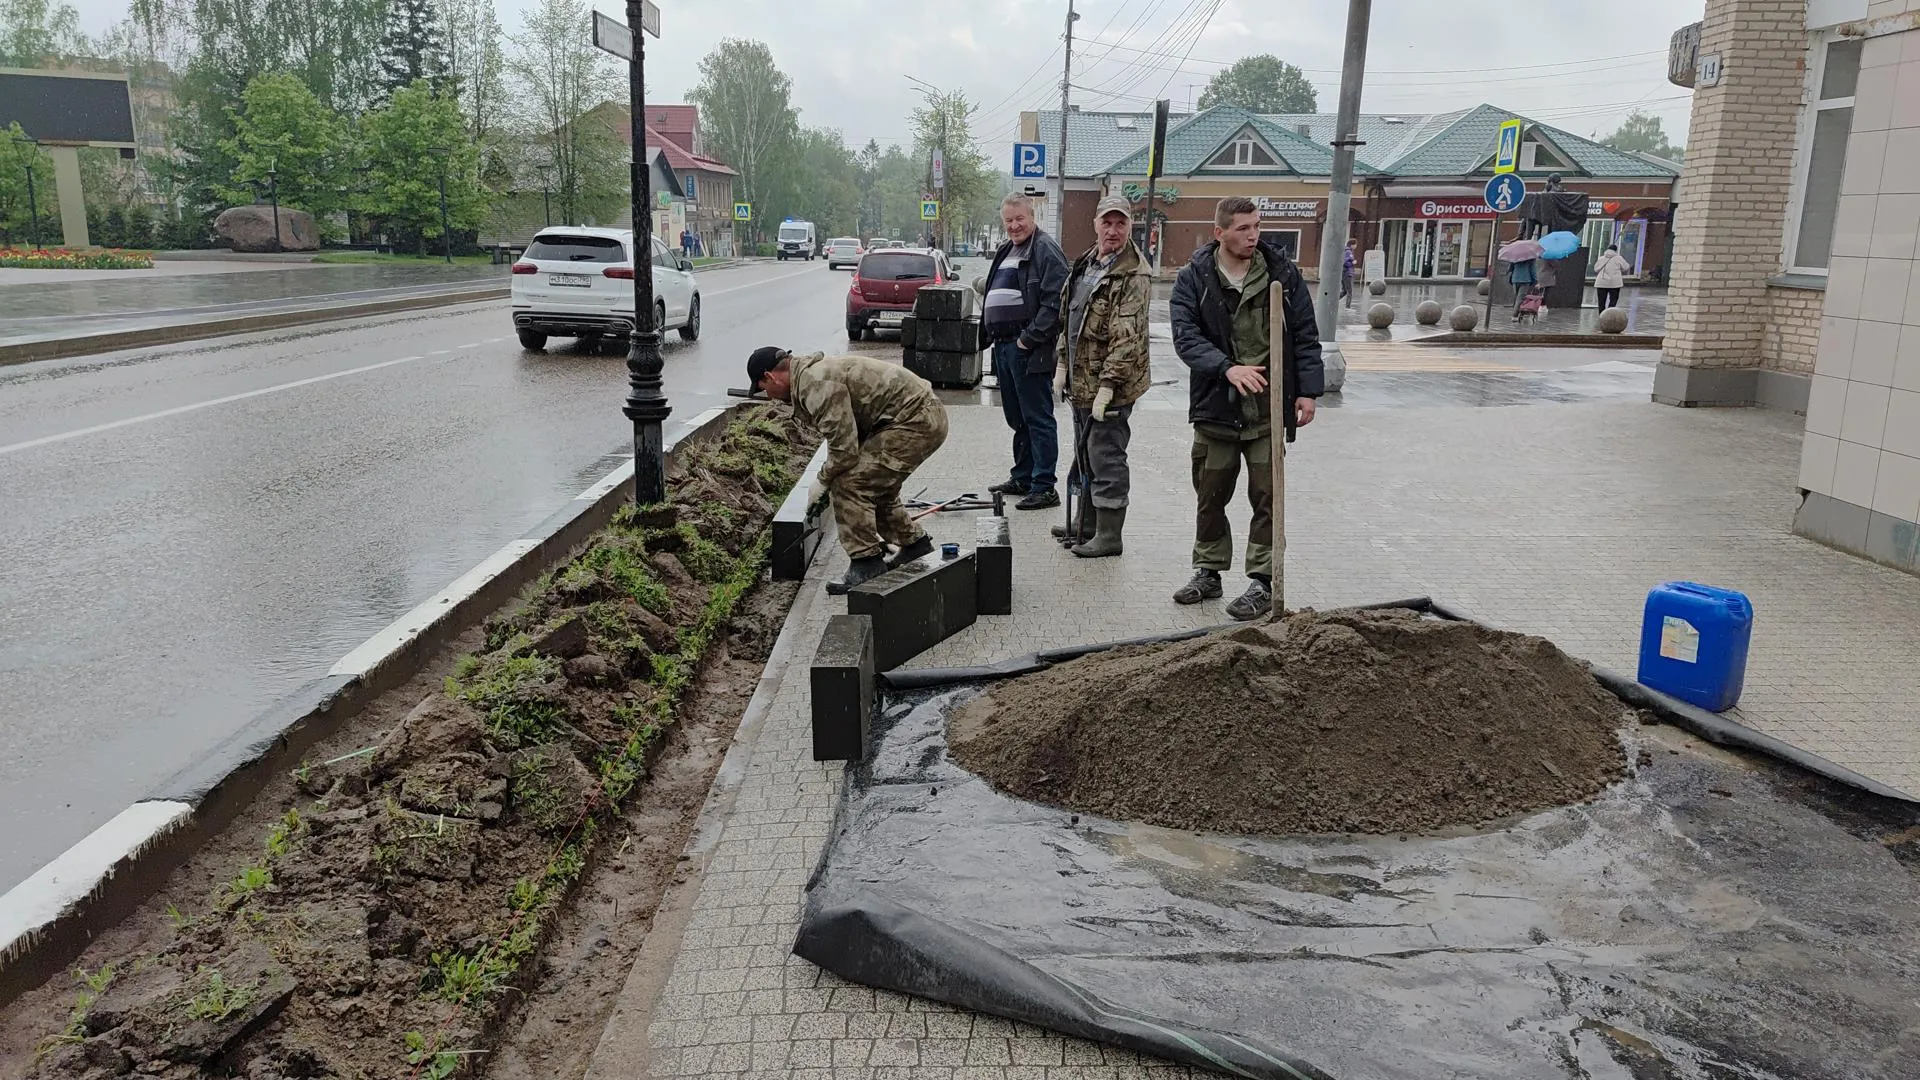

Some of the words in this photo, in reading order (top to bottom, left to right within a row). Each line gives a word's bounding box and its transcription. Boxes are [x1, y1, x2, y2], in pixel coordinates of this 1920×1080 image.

[1703, 61, 1716, 80] 14
[1020, 146, 1038, 174] P
[1422, 201, 1492, 215] Бристоль
